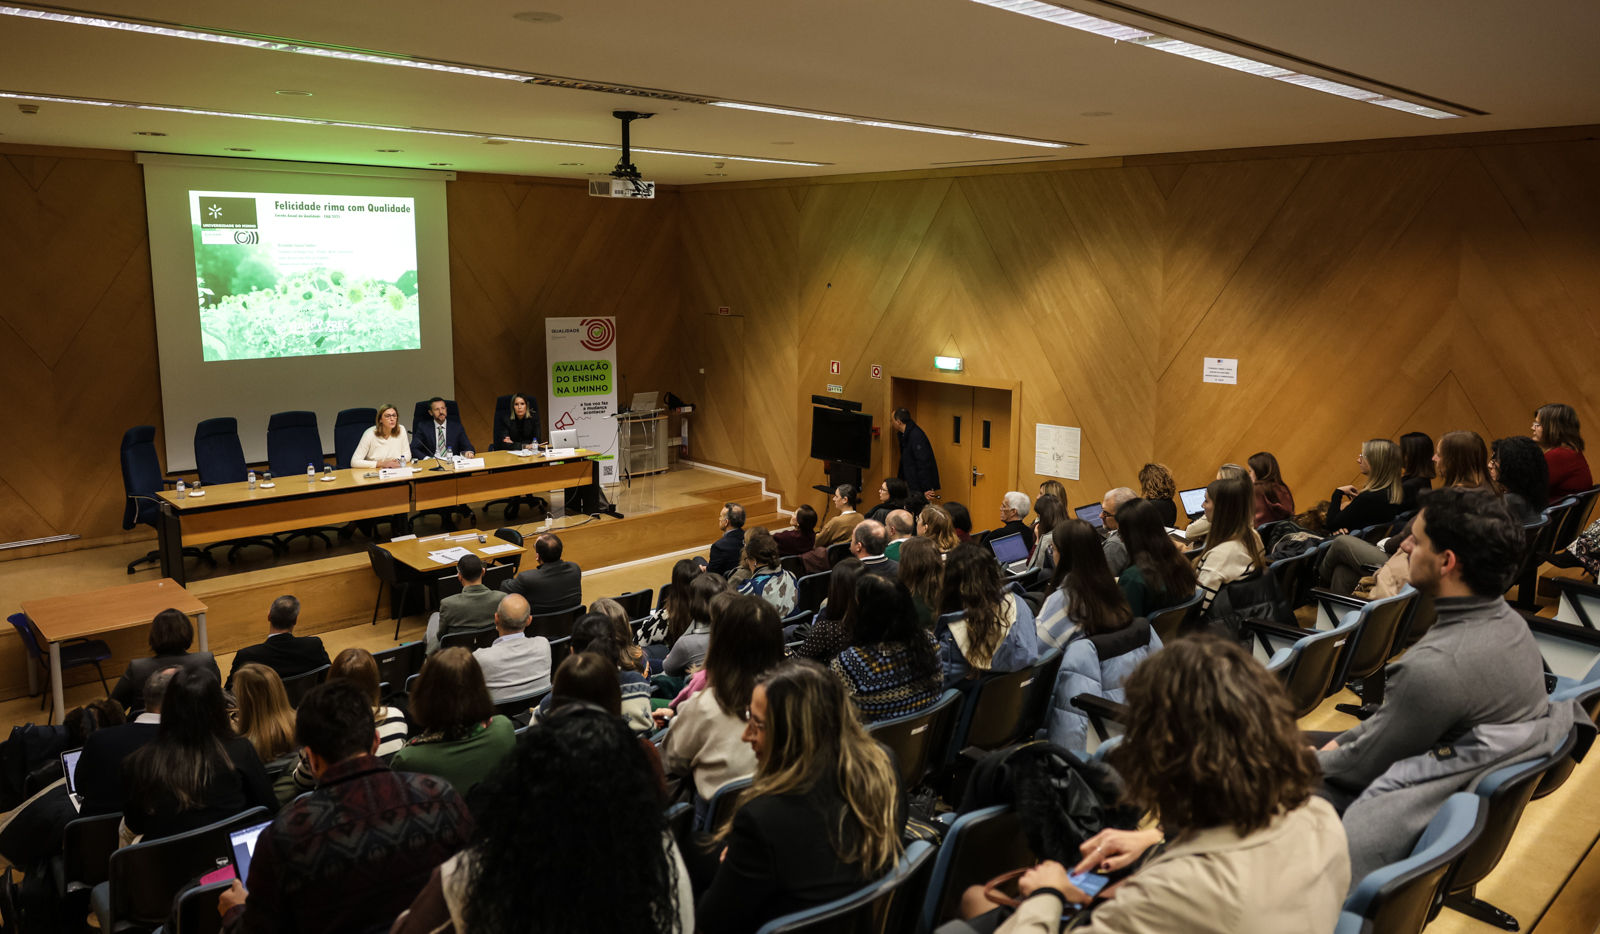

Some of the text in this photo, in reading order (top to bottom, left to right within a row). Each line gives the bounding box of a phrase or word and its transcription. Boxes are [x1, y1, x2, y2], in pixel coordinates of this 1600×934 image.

[275, 201, 321, 211] Felicidade
[324, 202, 345, 212] rima
[367, 203, 411, 213] Qualidade
[290, 321, 323, 330] HAPPY
[325, 320, 349, 329] TREE
[555, 362, 609, 373] AVALIAÇÃO
[556, 374, 606, 383] DO ENSINO
[557, 385, 608, 394] NA UMINHO
